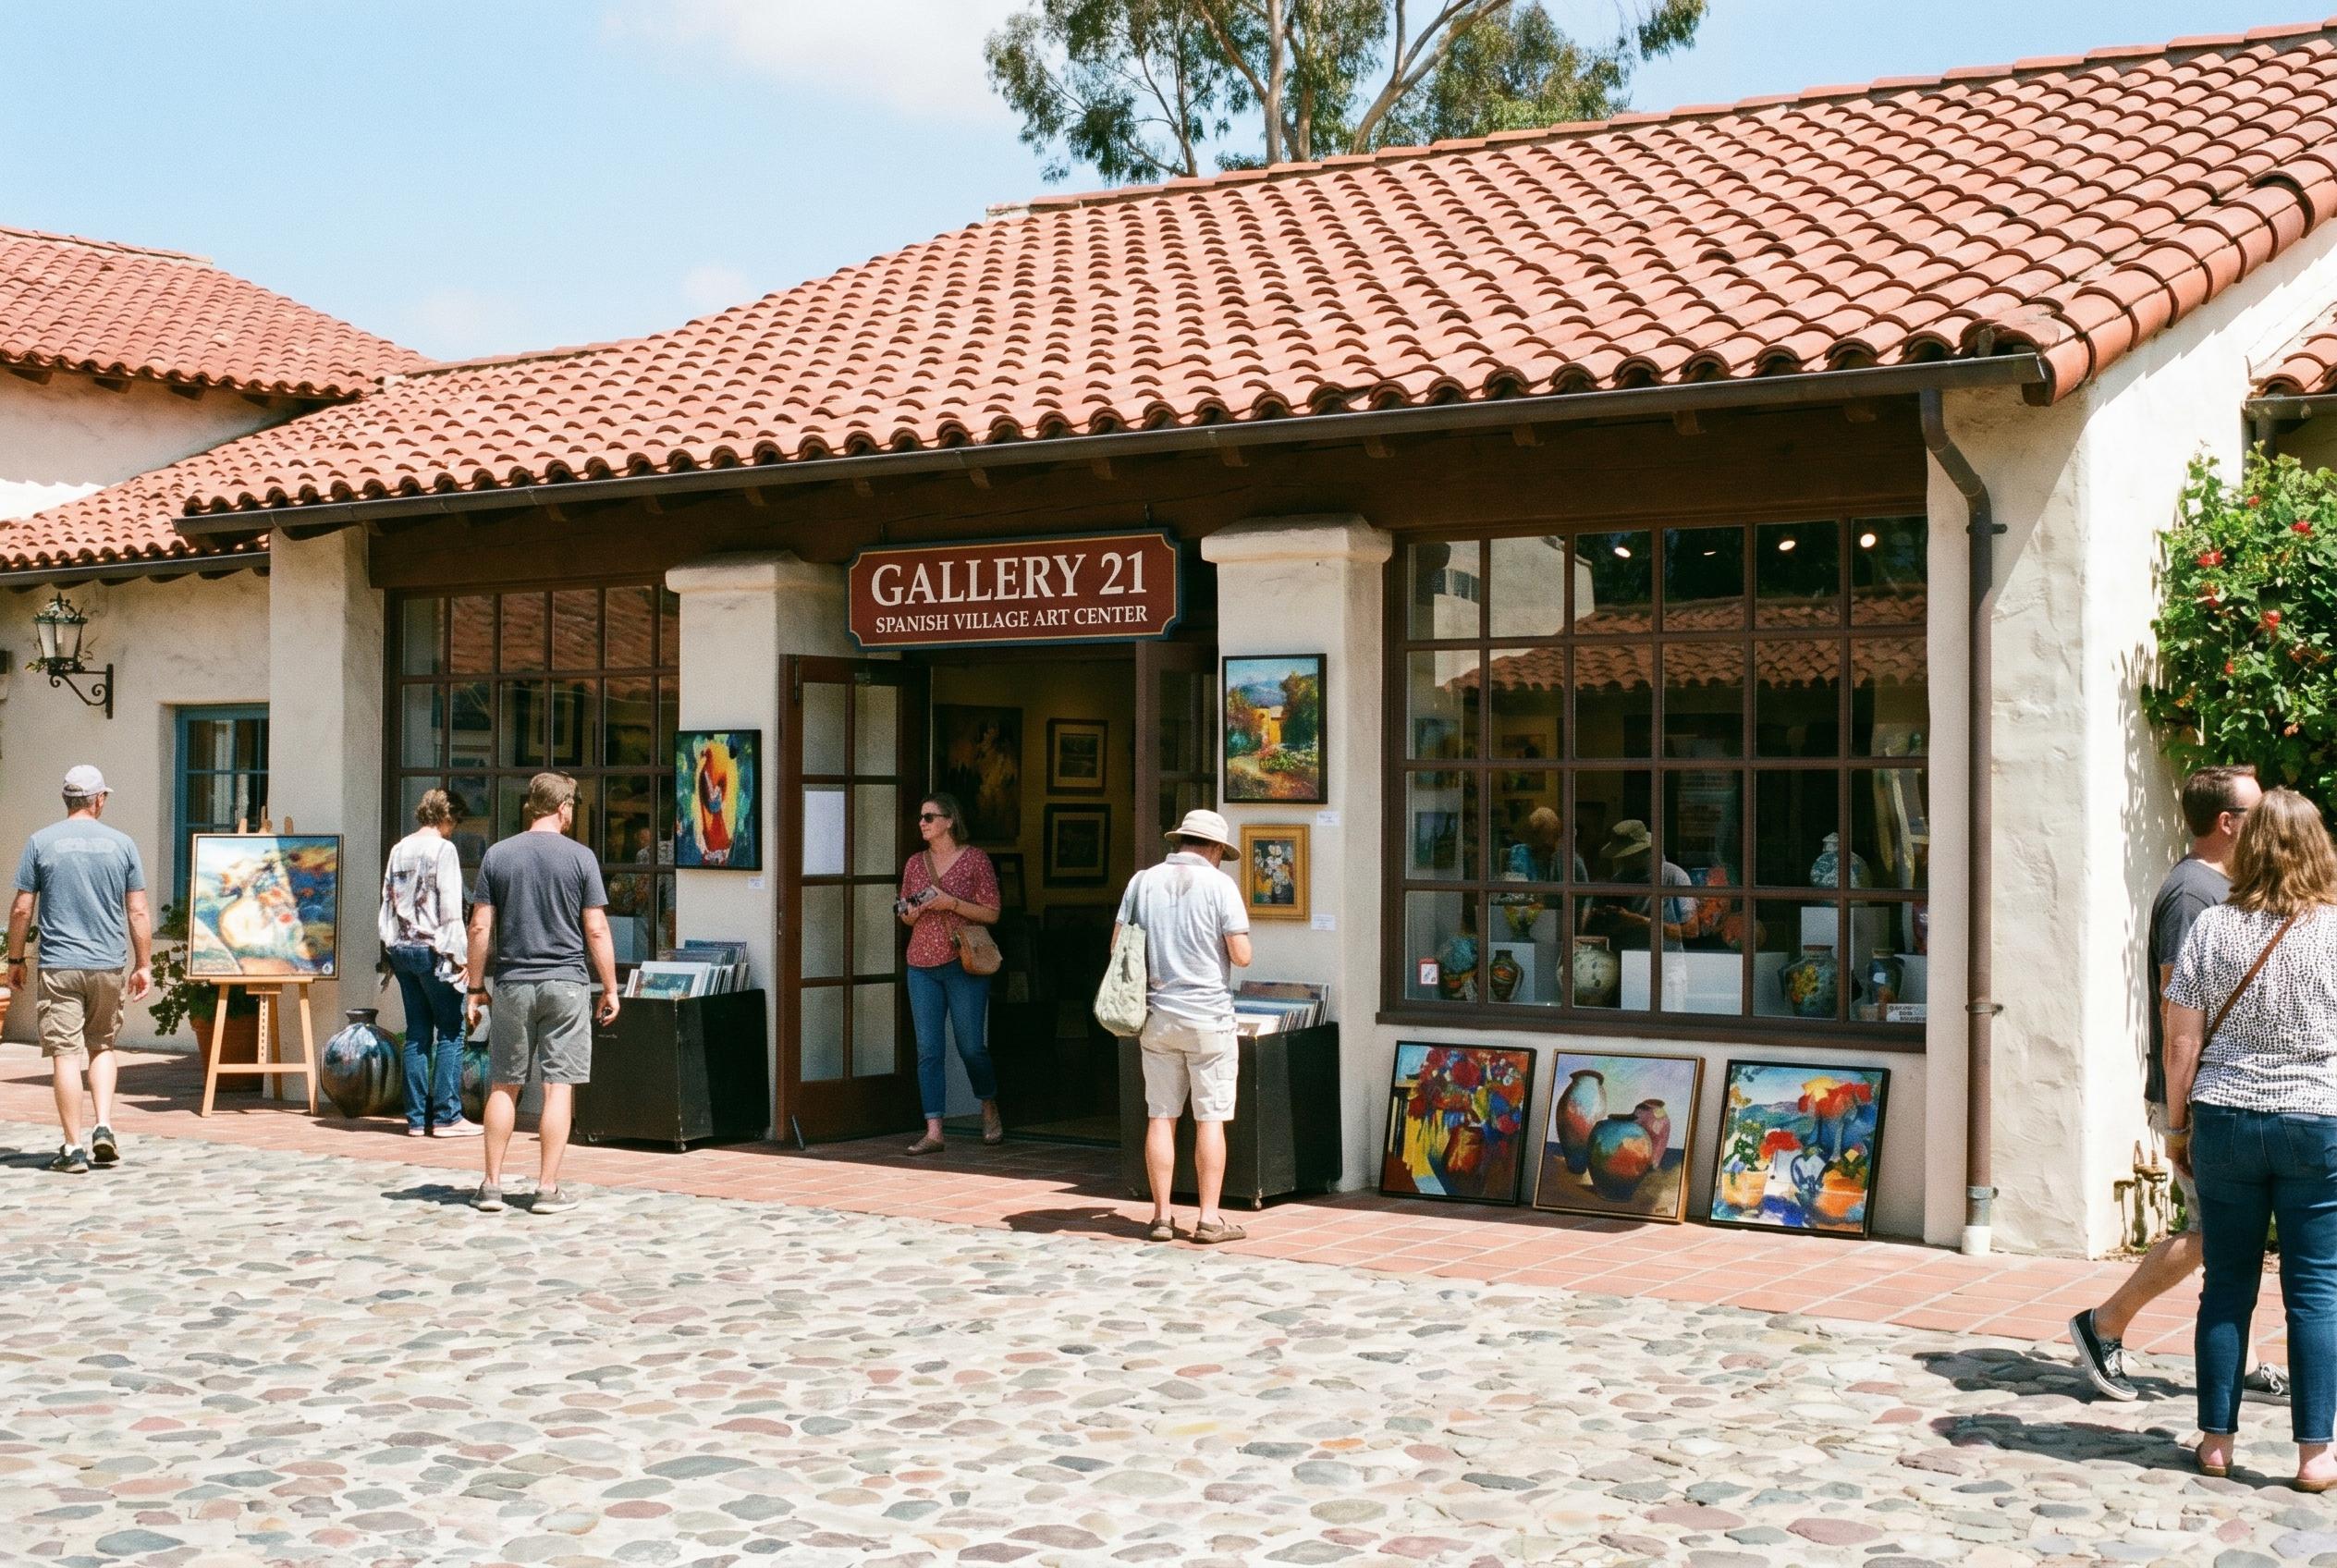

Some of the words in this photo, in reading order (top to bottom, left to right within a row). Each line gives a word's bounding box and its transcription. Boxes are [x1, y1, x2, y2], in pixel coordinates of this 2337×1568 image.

[871, 554, 1086, 606] GALLERY
[1099, 550, 1147, 595] 21
[875, 614, 949, 633] SPANISH
[953, 610, 1030, 630] VILLAGE
[1034, 608, 1070, 626] ART
[1073, 605, 1148, 624] CENTER
